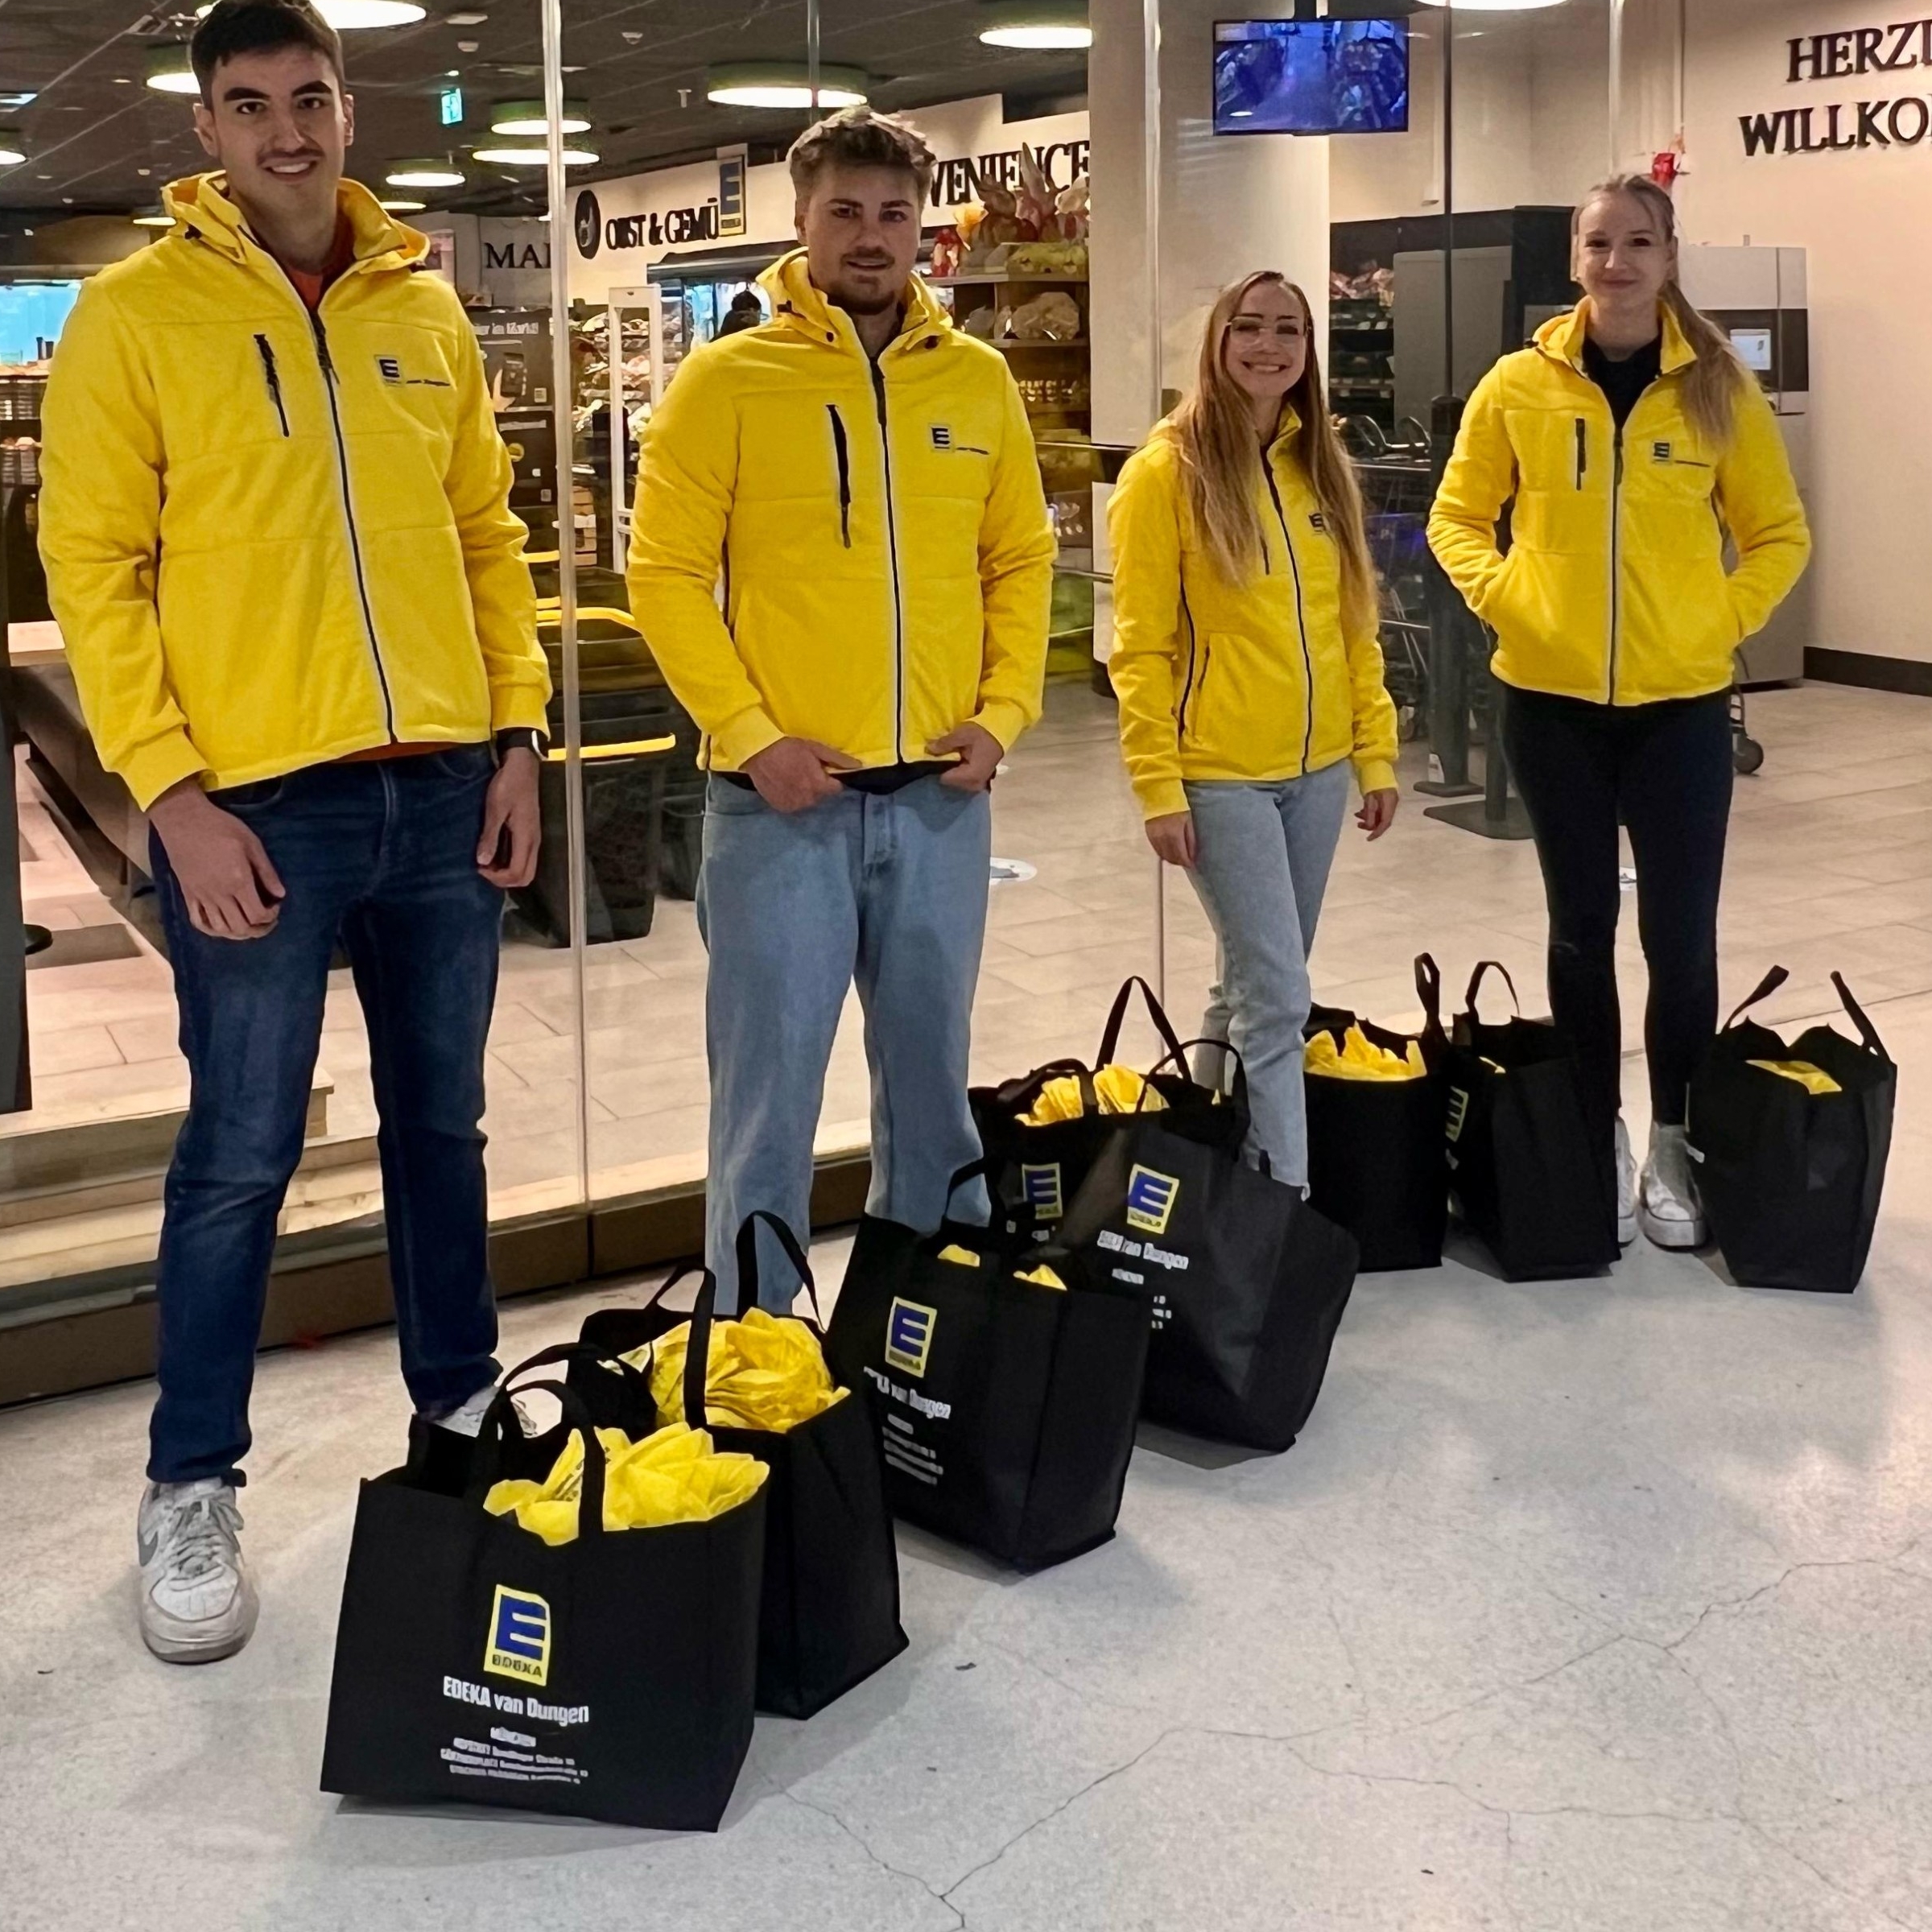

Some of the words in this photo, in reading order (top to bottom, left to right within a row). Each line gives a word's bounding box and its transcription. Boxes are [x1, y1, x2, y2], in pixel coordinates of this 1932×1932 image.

[1737, 94, 1932, 156] WILLKO
[649, 213, 663, 246] &
[495, 1594, 547, 1661] E
[444, 1676, 491, 1707] EDEKA
[494, 1694, 523, 1715] van
[527, 1698, 589, 1727] Dungen
